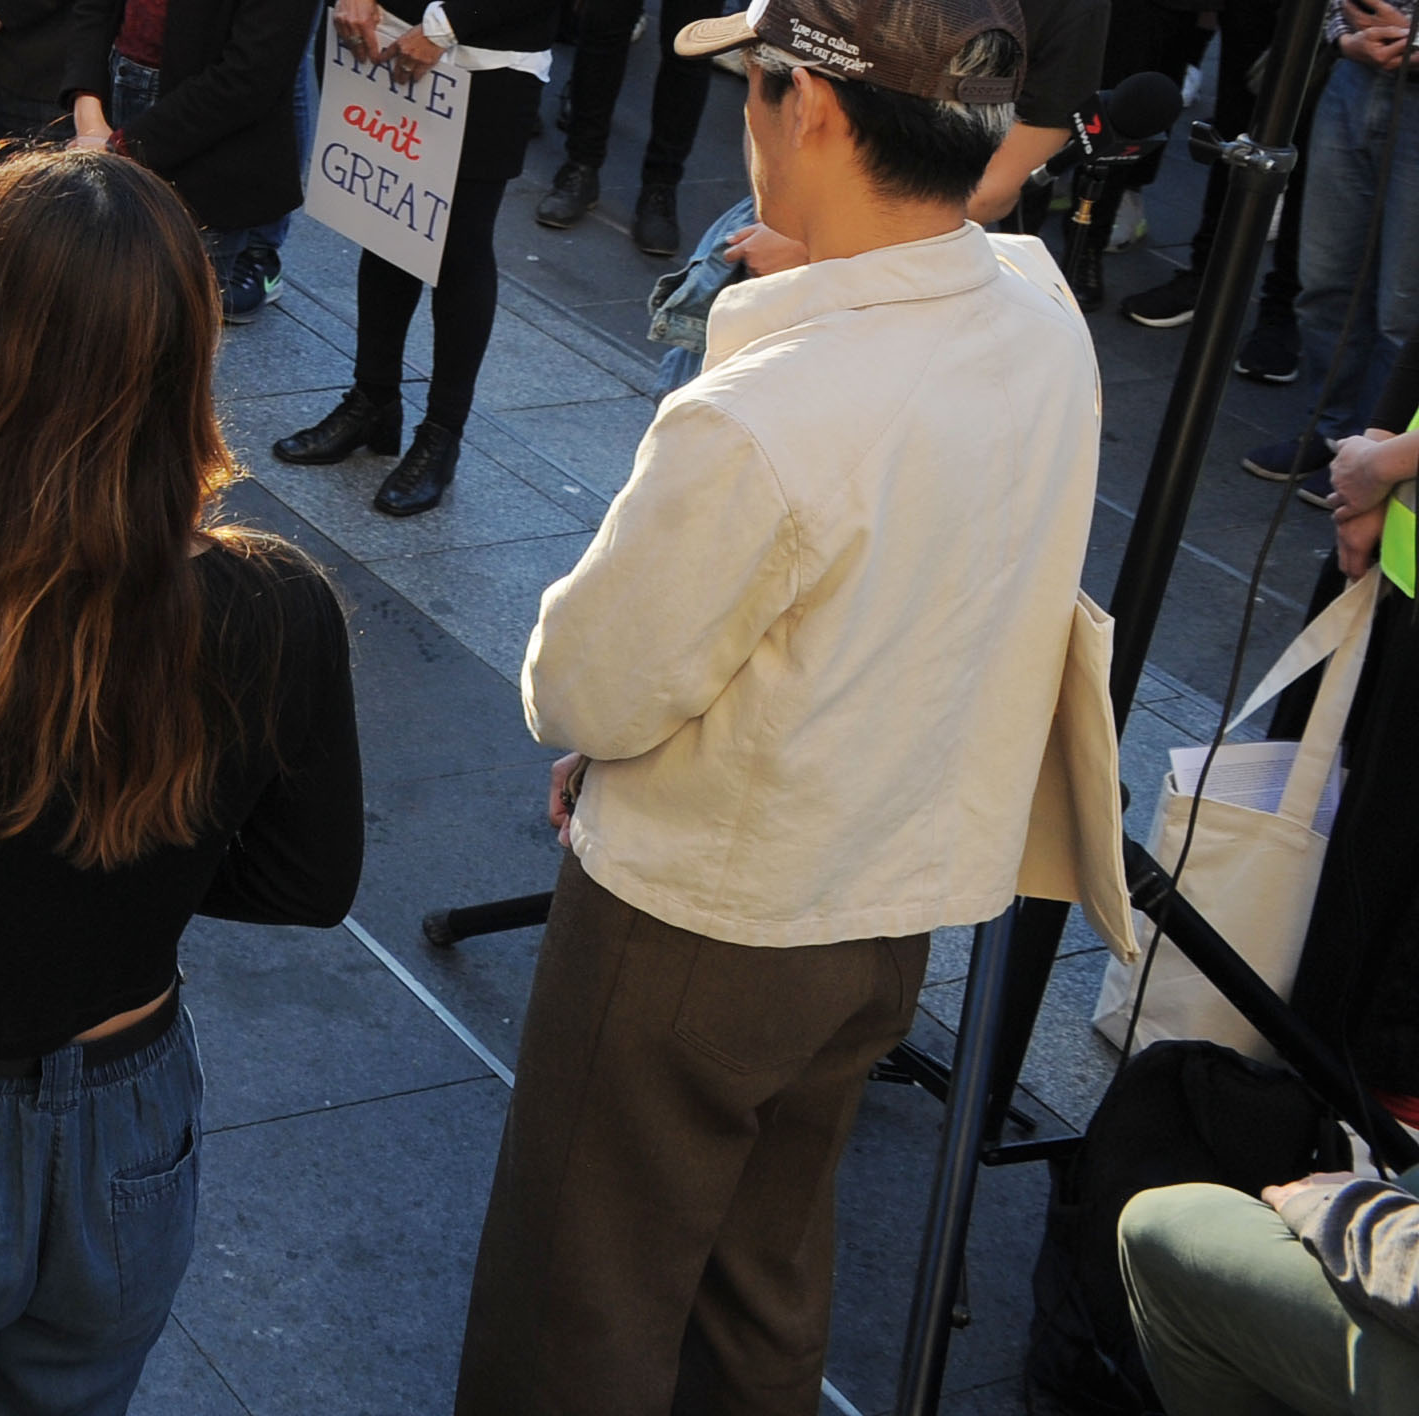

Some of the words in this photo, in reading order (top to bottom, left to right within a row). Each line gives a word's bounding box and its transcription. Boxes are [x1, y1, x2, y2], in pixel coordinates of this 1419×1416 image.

[791, 34, 813, 52] Love
[827, 37, 859, 55] culture
[343, 104, 422, 161] ain't
[1073, 112, 1093, 155] NEWS
[321, 142, 449, 242] GREAT
